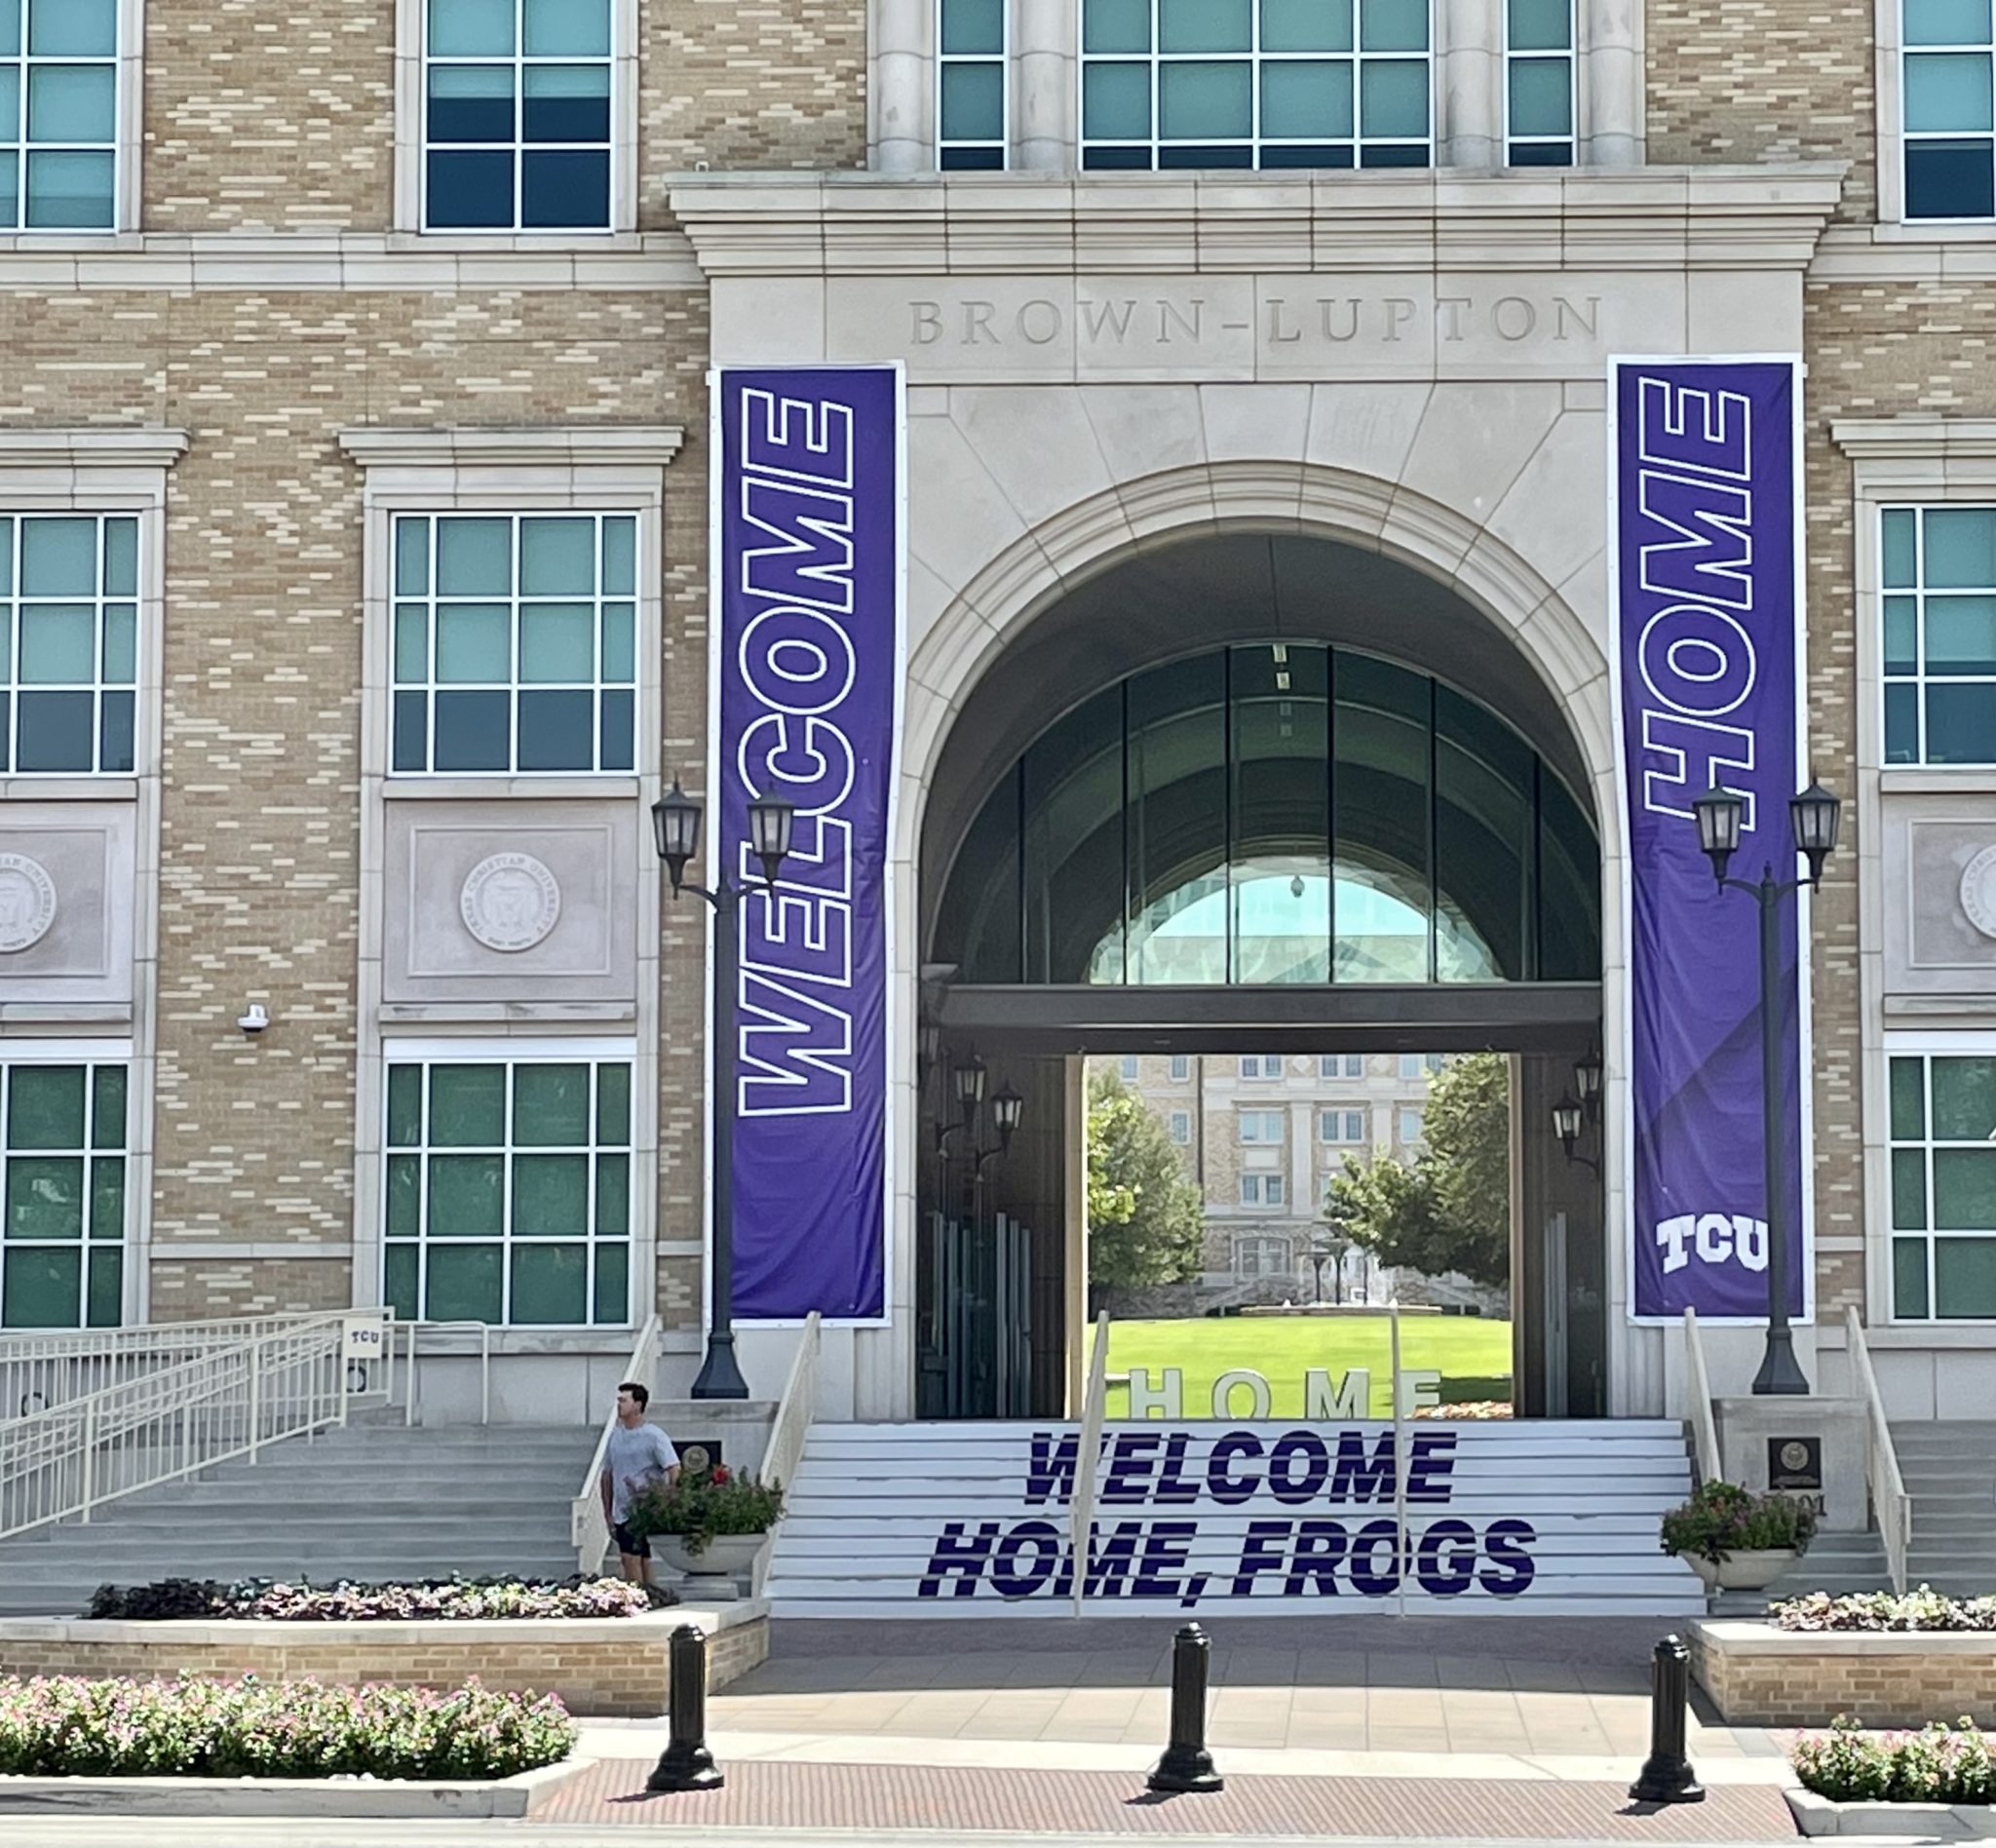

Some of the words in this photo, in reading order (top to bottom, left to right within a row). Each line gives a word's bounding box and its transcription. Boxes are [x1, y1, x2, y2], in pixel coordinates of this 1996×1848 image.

[908, 297, 1602, 344] BROWN-LUPTON
[1638, 376, 1756, 831] HOME
[738, 387, 856, 1117] WELCOME
[1657, 1213, 1768, 1274] TCU
[1129, 1367, 1442, 1419] HOME
[1024, 1430, 1457, 1505] WELCOME
[918, 1521, 1213, 1608] HOME,
[1231, 1519, 1537, 1600] FROGS
